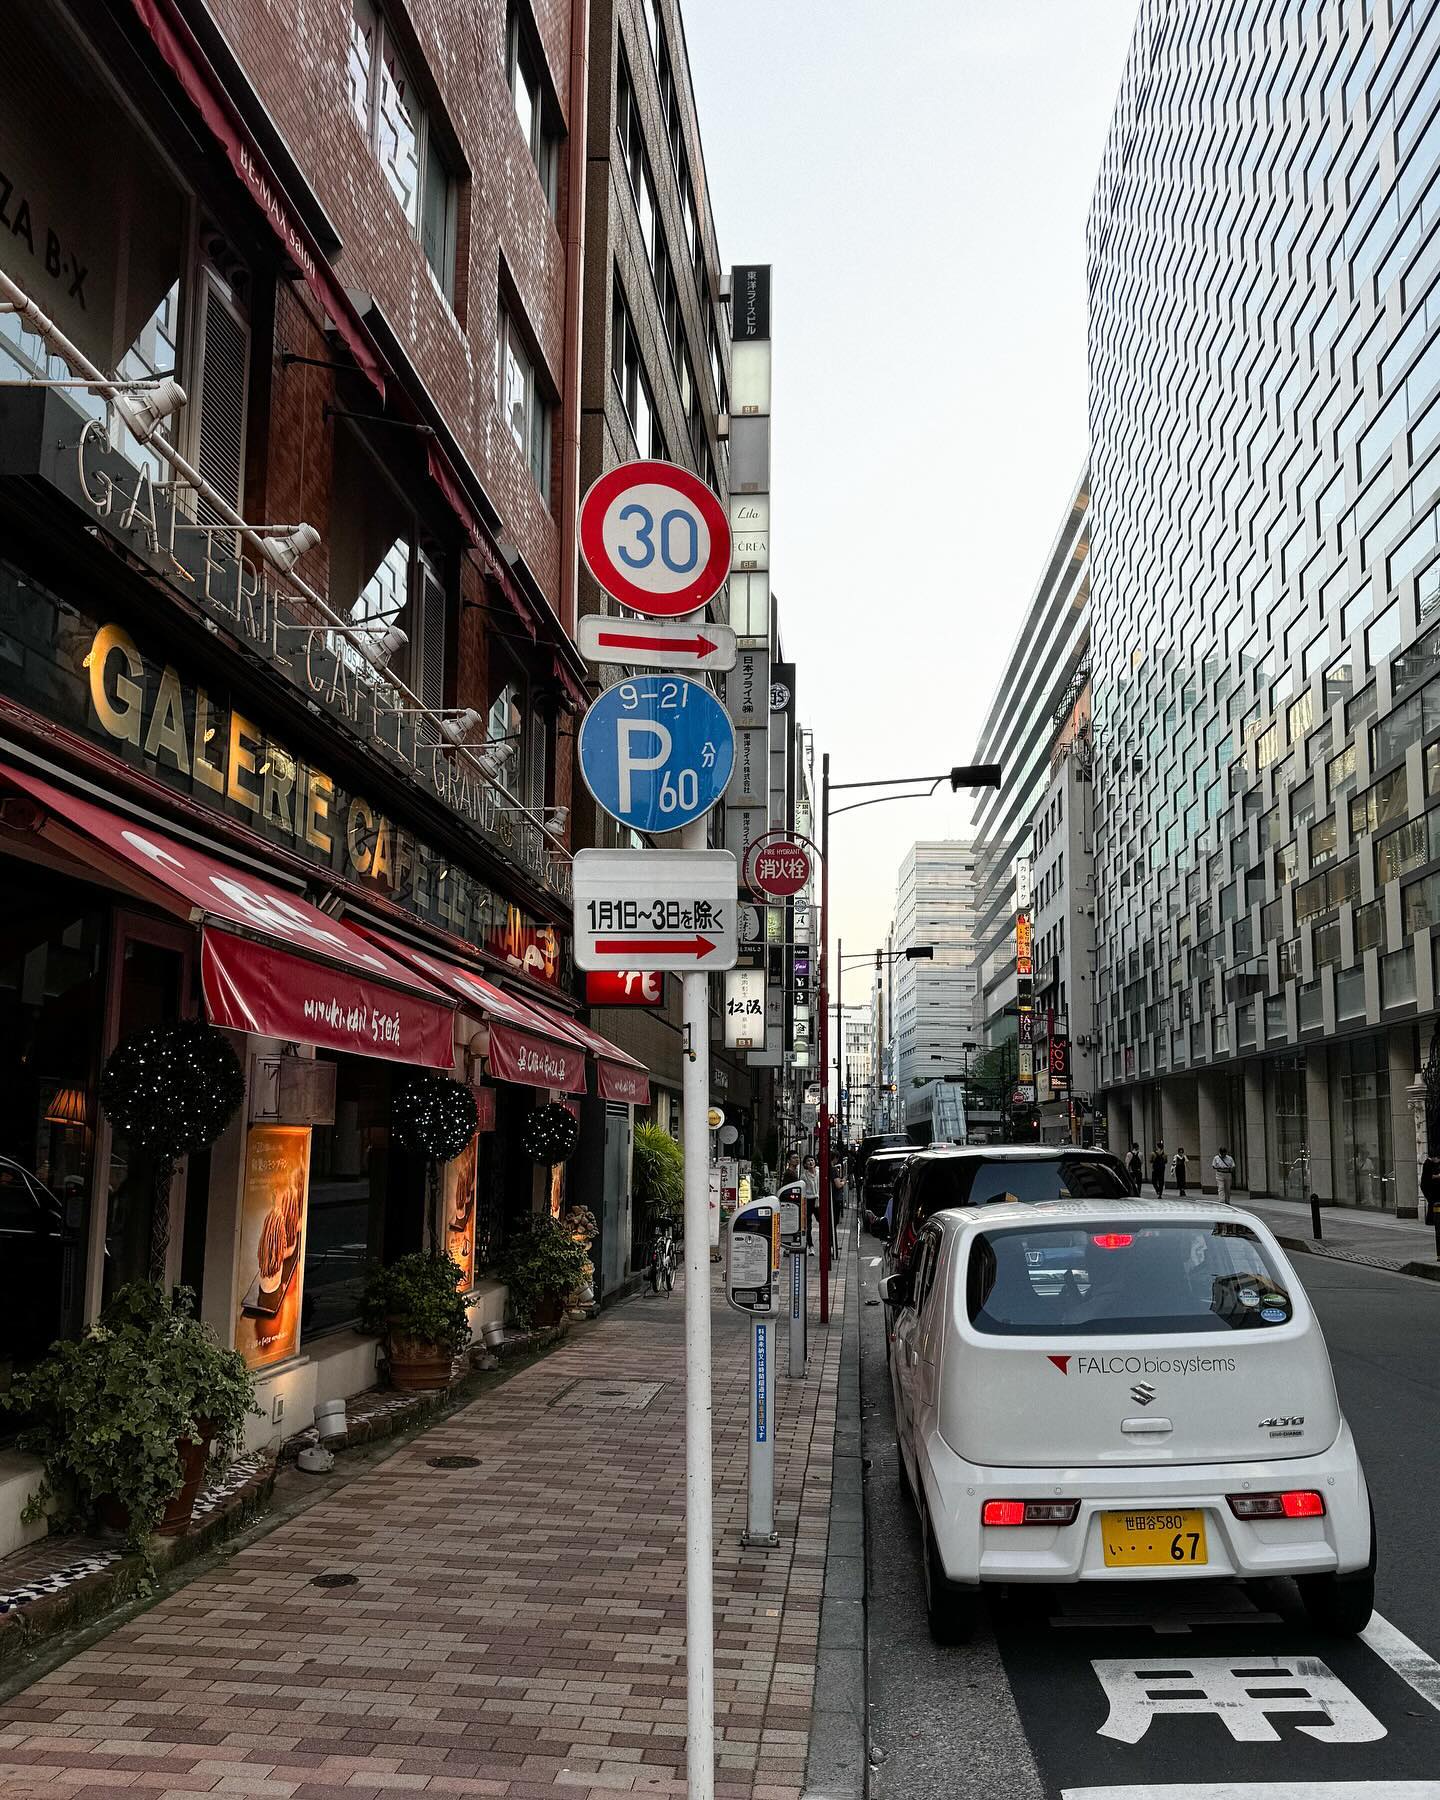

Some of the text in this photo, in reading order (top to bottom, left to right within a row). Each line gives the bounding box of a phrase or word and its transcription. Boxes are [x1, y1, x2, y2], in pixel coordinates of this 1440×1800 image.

[240, 143, 316, 279] BE-MAX salon
[746, 271, 757, 335] 東洋ライスビル
[617, 503, 698, 574] 30
[619, 682, 689, 710] 9-21
[89, 623, 332, 854] GALERIE
[616, 718, 673, 814] P
[701, 741, 716, 768] 分
[658, 768, 699, 813] 60
[763, 848, 800, 856] FIRE HYDRANT
[759, 858, 806, 880] 消火栓
[726, 998, 763, 1016] 松阪
[1024, 1015, 1032, 1040] AGA
[1053, 1040, 1067, 1071] 300
[1078, 1355, 1236, 1376] FALCO biosystems
[1258, 1416, 1305, 1428] ALTO
[1090, 1655, 1389, 1745] 用
